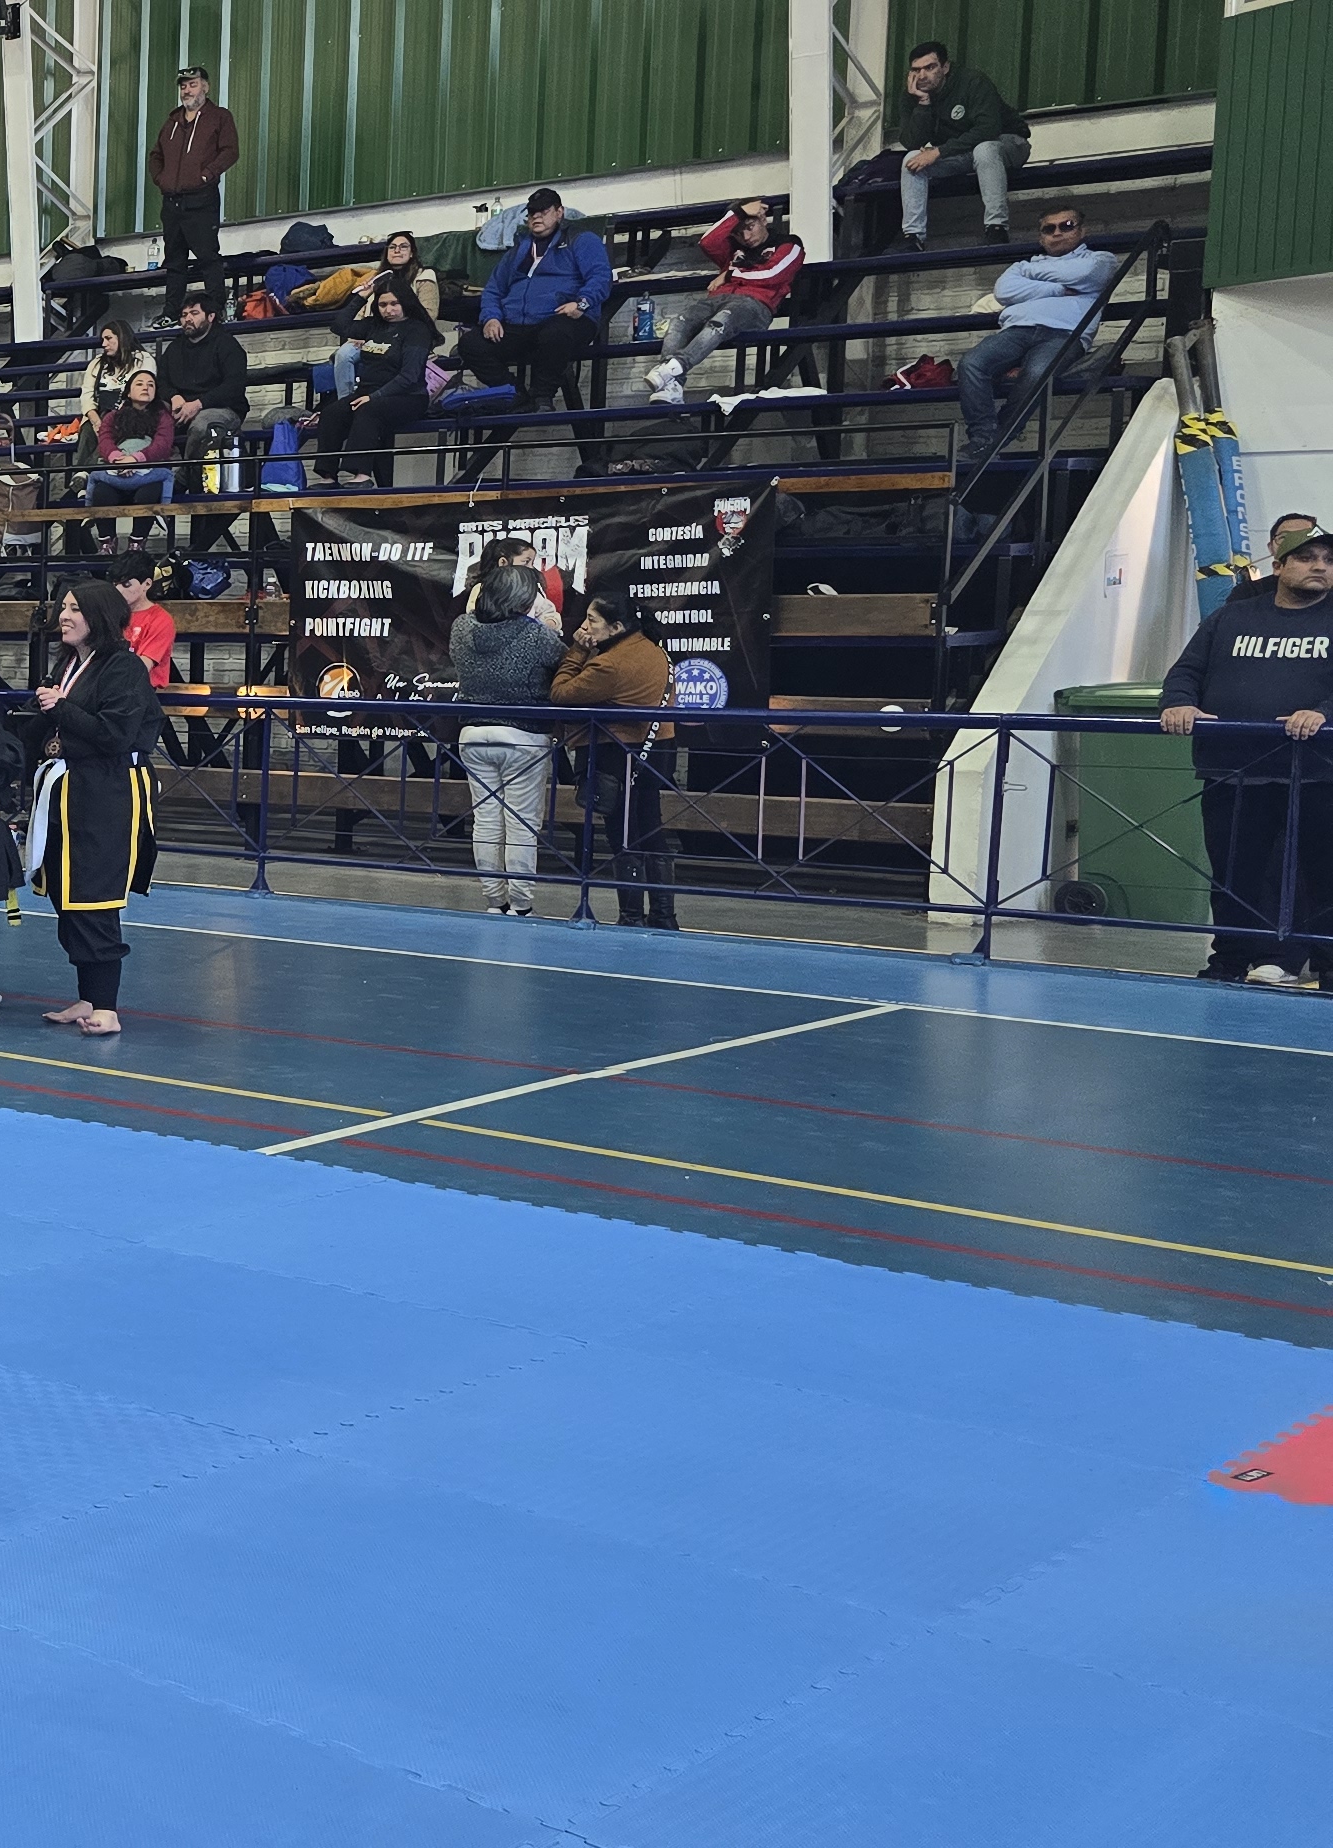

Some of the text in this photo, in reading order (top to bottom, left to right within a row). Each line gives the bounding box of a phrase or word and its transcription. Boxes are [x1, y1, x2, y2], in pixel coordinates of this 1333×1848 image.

[648, 522, 704, 542] CORTESÍA
[305, 541, 434, 562] TAEKWON-DO ITF
[640, 553, 710, 570] INTEGRIDAD
[452, 525, 590, 599] PAM
[304, 579, 393, 599] KICKBOXING
[629, 580, 721, 598] PERSEVERANCIA
[304, 617, 392, 637] POINTFIGHT
[1231, 635, 1330, 659] HILFIGER
[675, 681, 717, 695] WAKO
[677, 694, 710, 704] CHILE
[295, 724, 311, 734] San
[311, 725, 340, 737] Felipe,
[341, 725, 371, 737] Región
